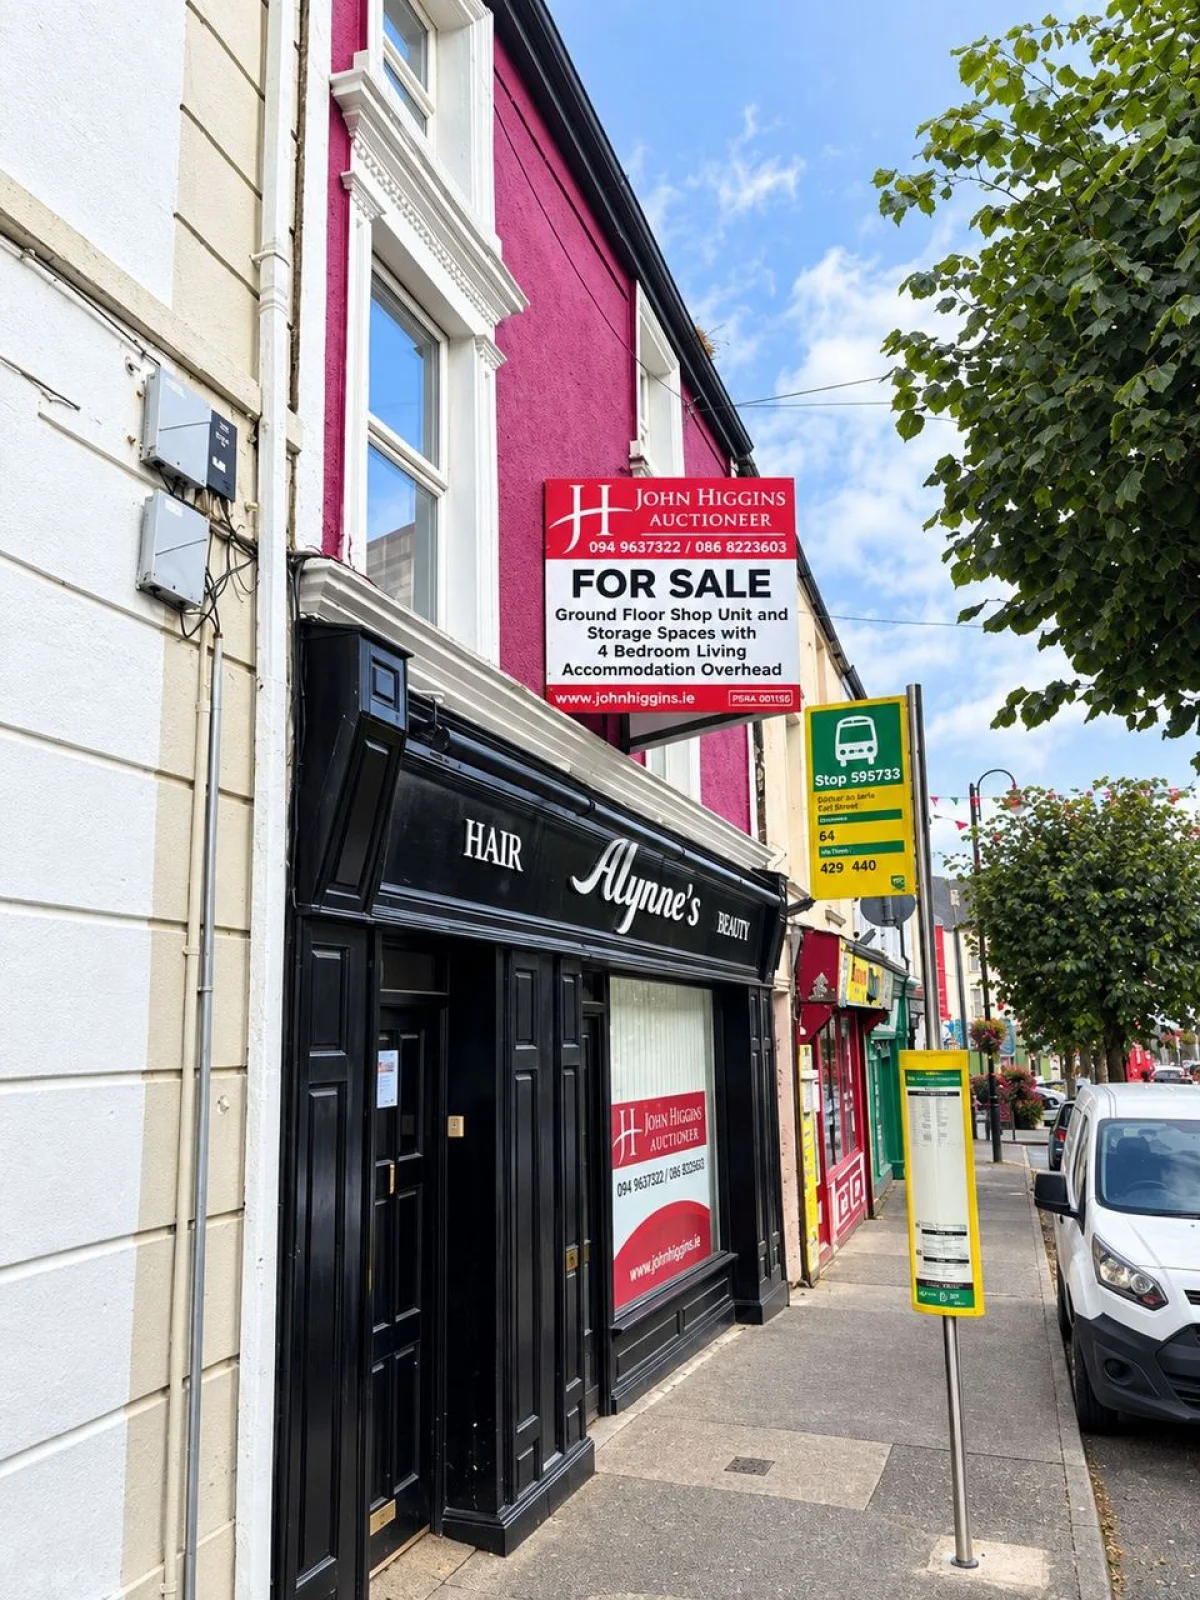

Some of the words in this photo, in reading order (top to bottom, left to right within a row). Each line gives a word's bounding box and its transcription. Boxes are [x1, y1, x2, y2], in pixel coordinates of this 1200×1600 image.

[635, 487, 690, 511] JOHN
[697, 487, 786, 506] HIGGINS
[650, 513, 772, 528] AUCTIONEER
[589, 541, 615, 554] 094
[620, 541, 681, 554] 9637322
[684, 541, 691, 554] /
[695, 541, 721, 554] 086
[726, 541, 787, 554] 8223603
[572, 568, 656, 599] FOR
[669, 568, 771, 599] SALE
[555, 608, 617, 622] Ground
[623, 608, 665, 622] Floor
[671, 608, 712, 624] Shop
[718, 608, 752, 622] Unit
[757, 608, 789, 622] and
[587, 626, 652, 642] Storage
[657, 626, 716, 642] Spaces
[721, 625, 757, 640] with
[597, 645, 608, 658] 4
[614, 644, 690, 658] Bedroom
[697, 644, 747, 660] Living
[562, 663, 696, 677] Accommodation
[701, 663, 782, 677] Overhead
[555, 691, 695, 706] www.johnhiggins.ie
[815, 773, 847, 788] Stop
[851, 768, 901, 783] 595733
[819, 830, 835, 842] 64
[820, 861, 844, 874] 429
[852, 859, 877, 872] 440
[463, 818, 524, 872] HAIR
[570, 837, 700, 935] Alynne's
[716, 910, 751, 942] BEAUTY
[644, 1111, 668, 1138] JOHN
[669, 1105, 702, 1127] HIGGINS
[649, 1127, 700, 1153] AUCTIONEER
[617, 1180, 632, 1198] 094
[633, 1169, 665, 1191] 9637322
[629, 1233, 701, 1282] www.johnhiggins.ie
